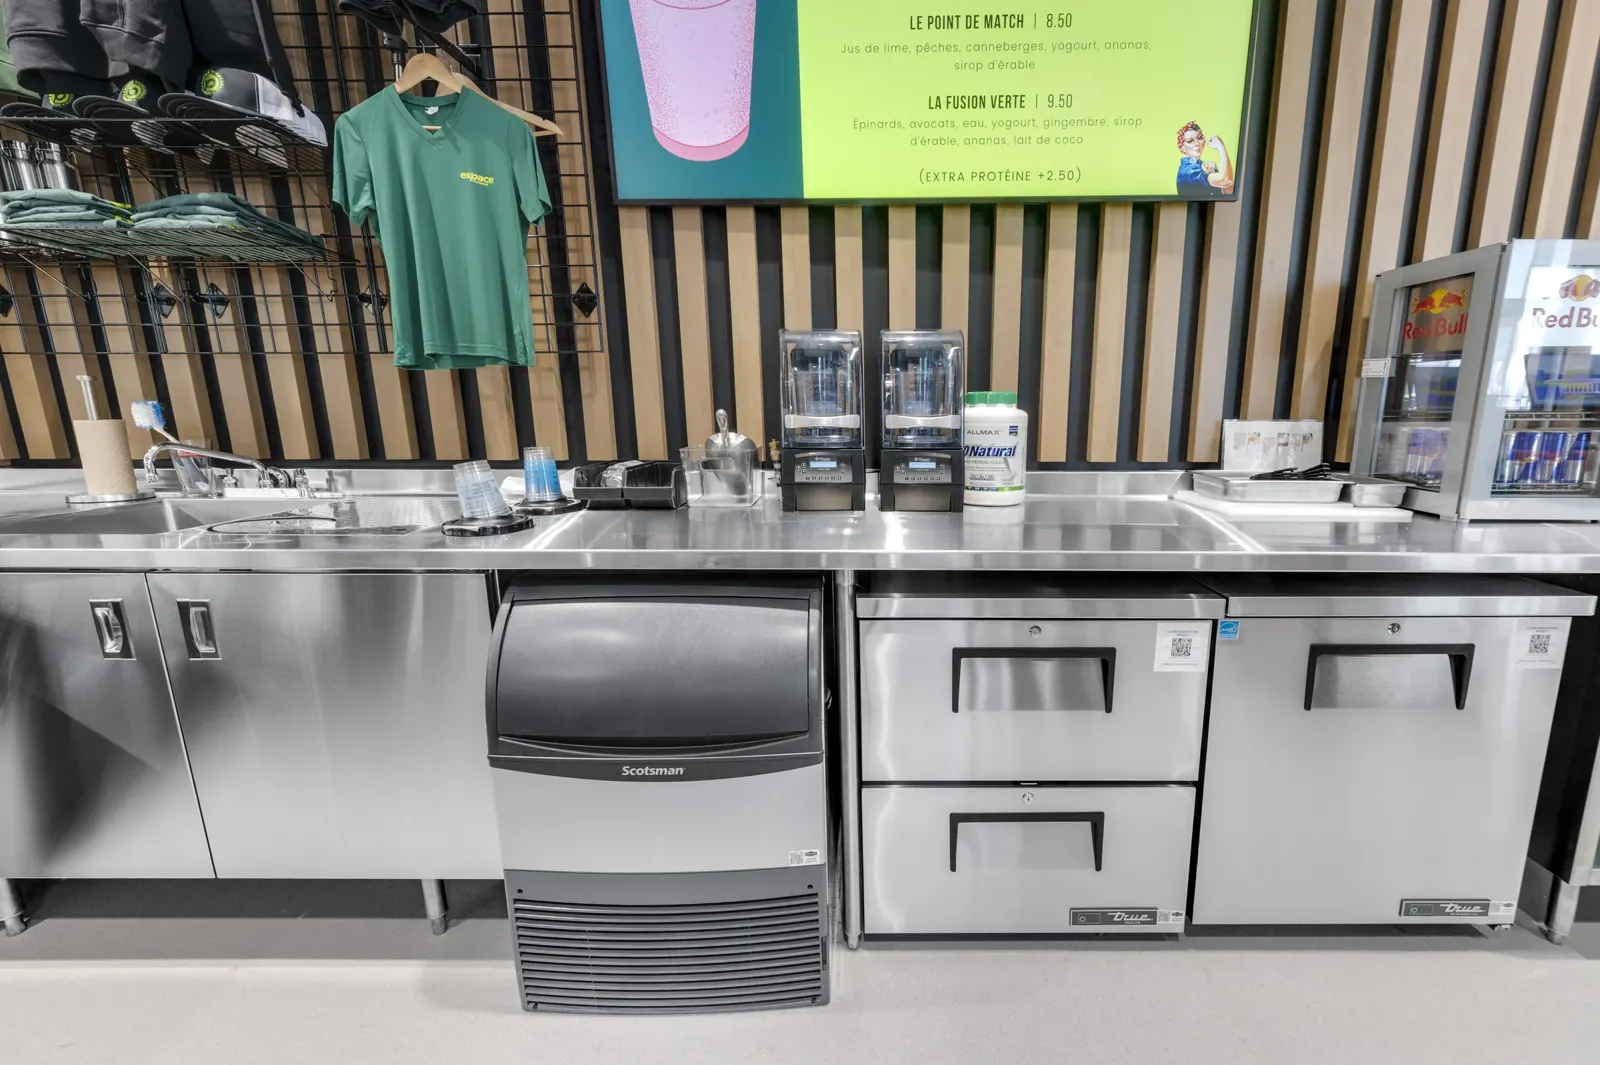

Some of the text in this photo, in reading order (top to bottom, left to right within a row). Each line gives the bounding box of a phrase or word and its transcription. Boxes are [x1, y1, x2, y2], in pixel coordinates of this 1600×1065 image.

[910, 12, 1073, 30] LE POINT DE MATCH 8.50
[840, 40, 1152, 56] Jus de lime, pêches, canneberges, yogourt, ananas,
[953, 59, 1036, 73] sirop d'érable
[928, 93, 1073, 110] LA FUSION VERTE 9.50
[853, 115, 1143, 131] Épinards, avocats, eau, yogourt, gingembre, sirop
[909, 134, 1084, 147] d'érable, ananas, lait de coco
[919, 166, 1082, 185] (EXTRA PROTÉINE +2.50)
[1532, 306, 1576, 328] Red
[1403, 313, 1469, 340] Red Bull
[621, 765, 684, 776] Scotsman
